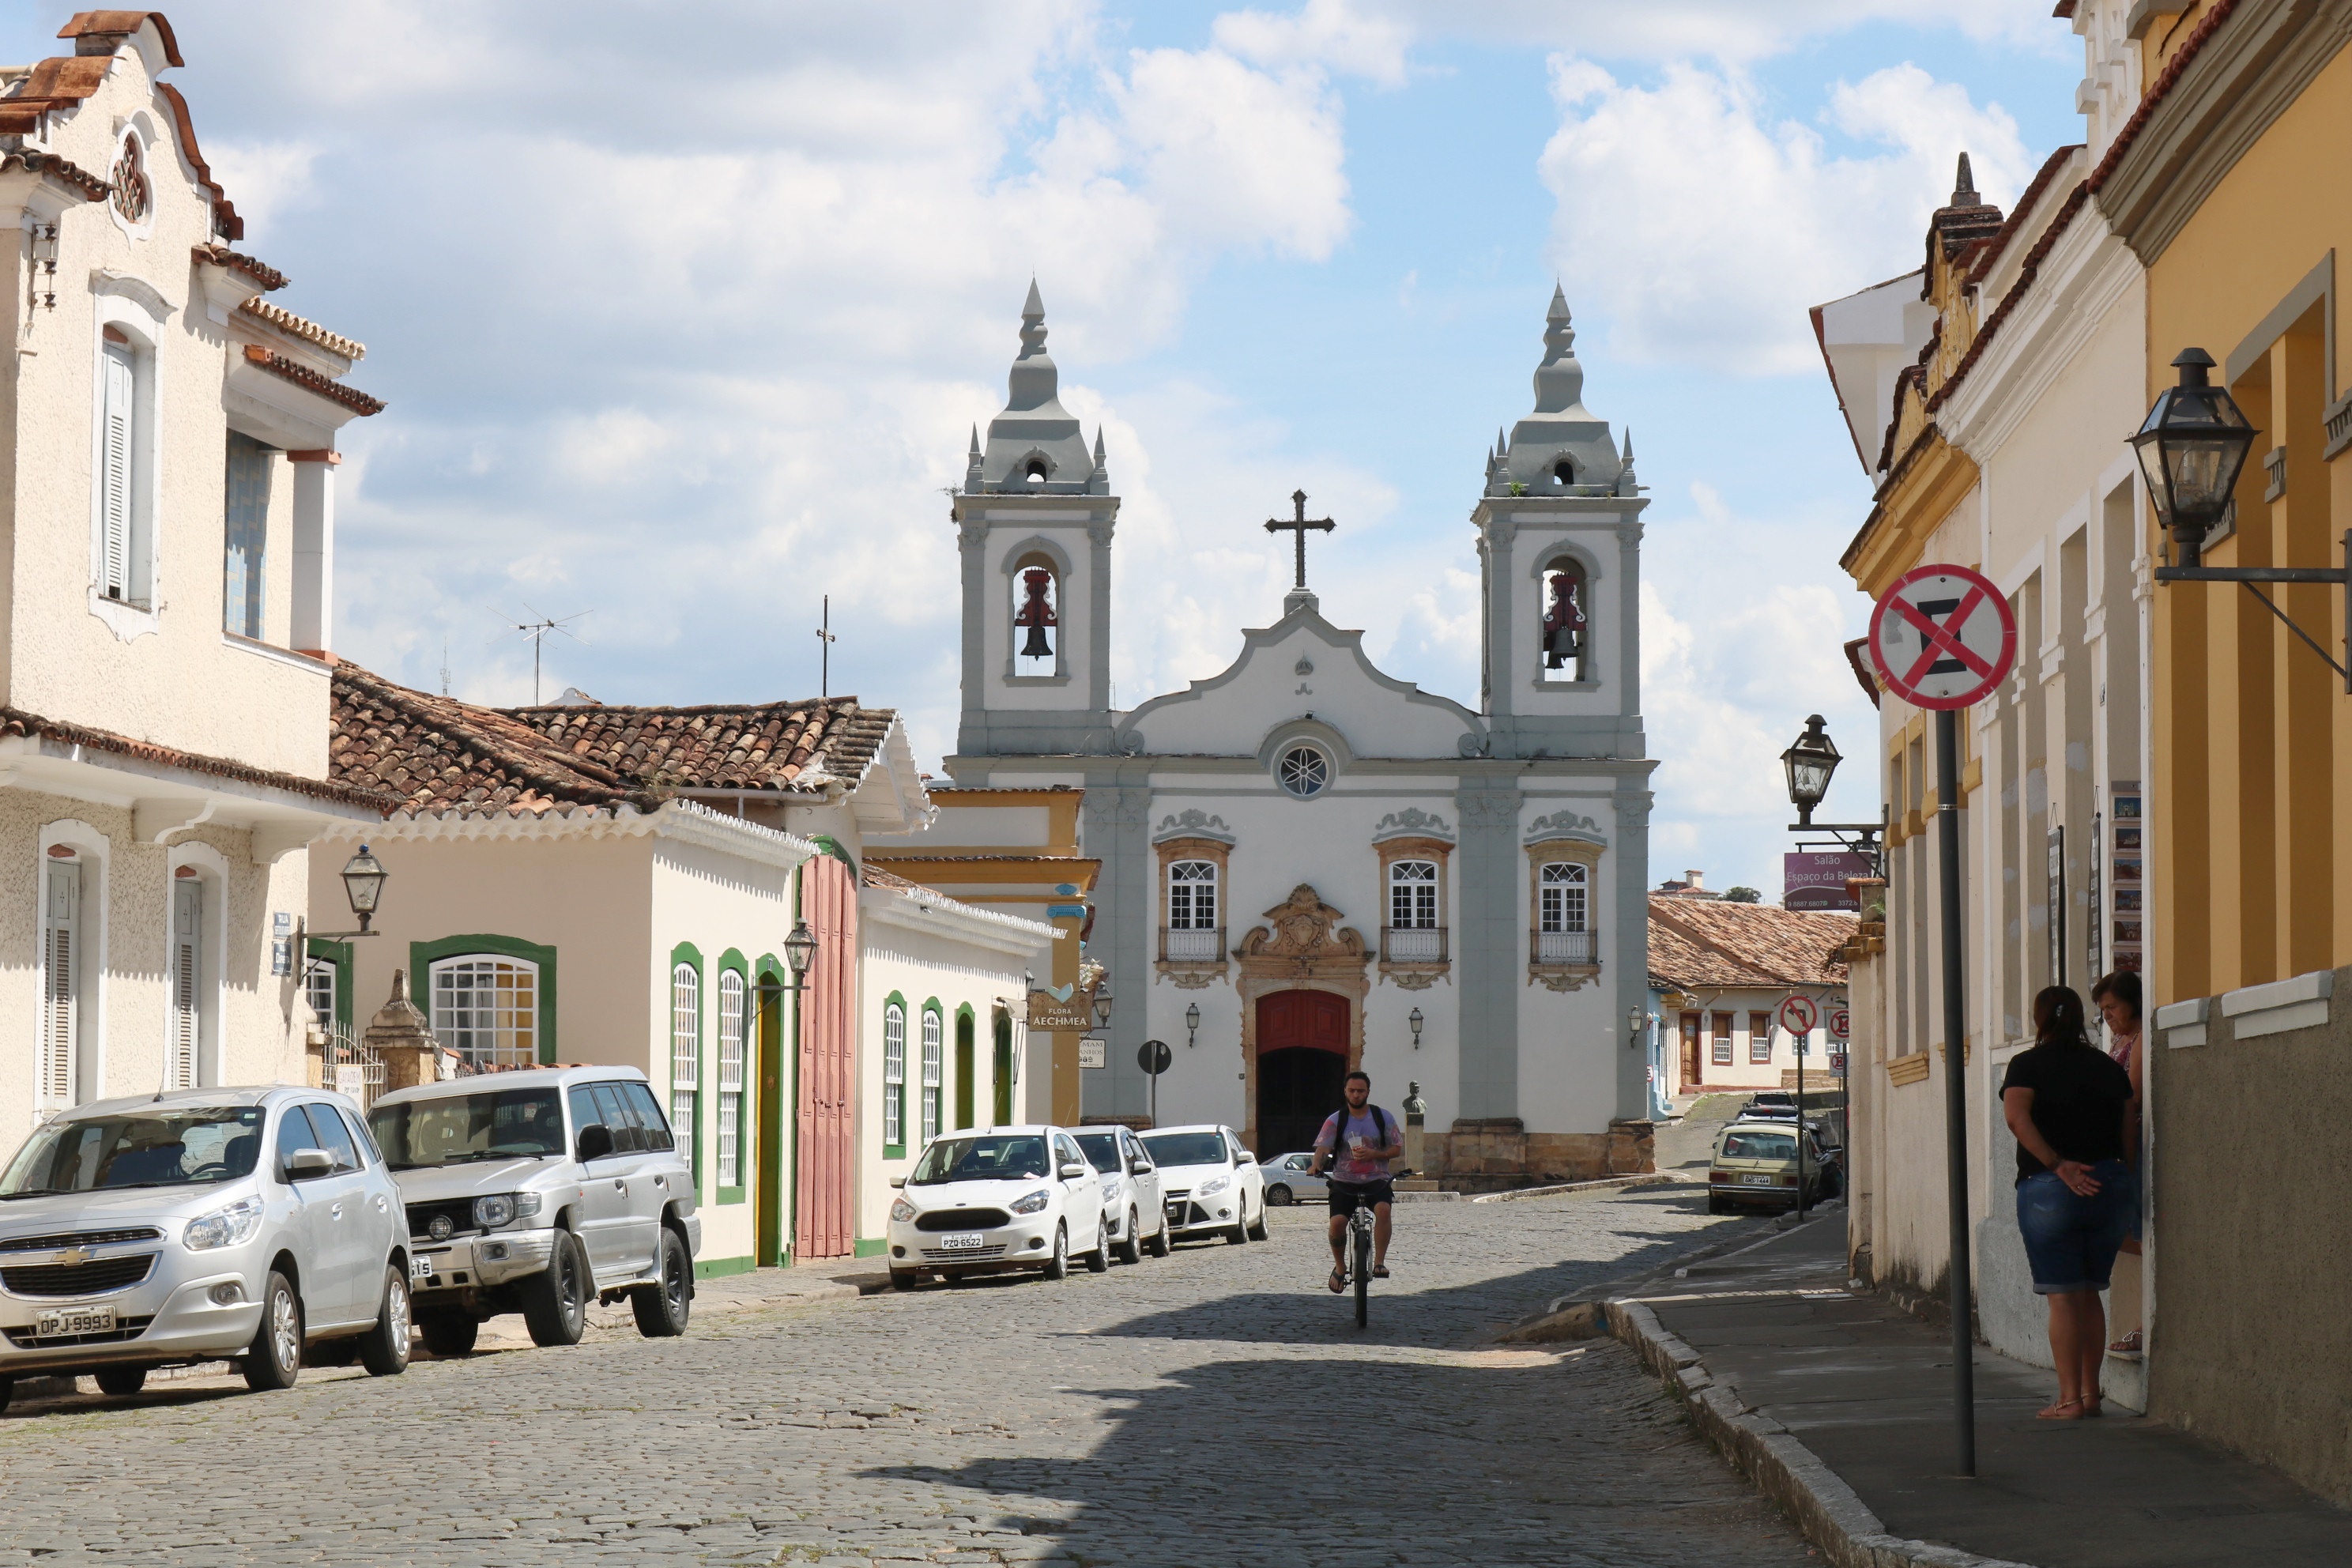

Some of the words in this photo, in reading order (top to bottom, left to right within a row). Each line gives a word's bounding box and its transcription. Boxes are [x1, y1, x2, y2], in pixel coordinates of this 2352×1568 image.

[1814, 854, 1841, 865] Salão
[1787, 872, 1820, 884] Espaço
[1822, 871, 1835, 881] da
[1838, 870, 1868, 880] Beleza
[1033, 1016, 1087, 1026] AECHMEA
